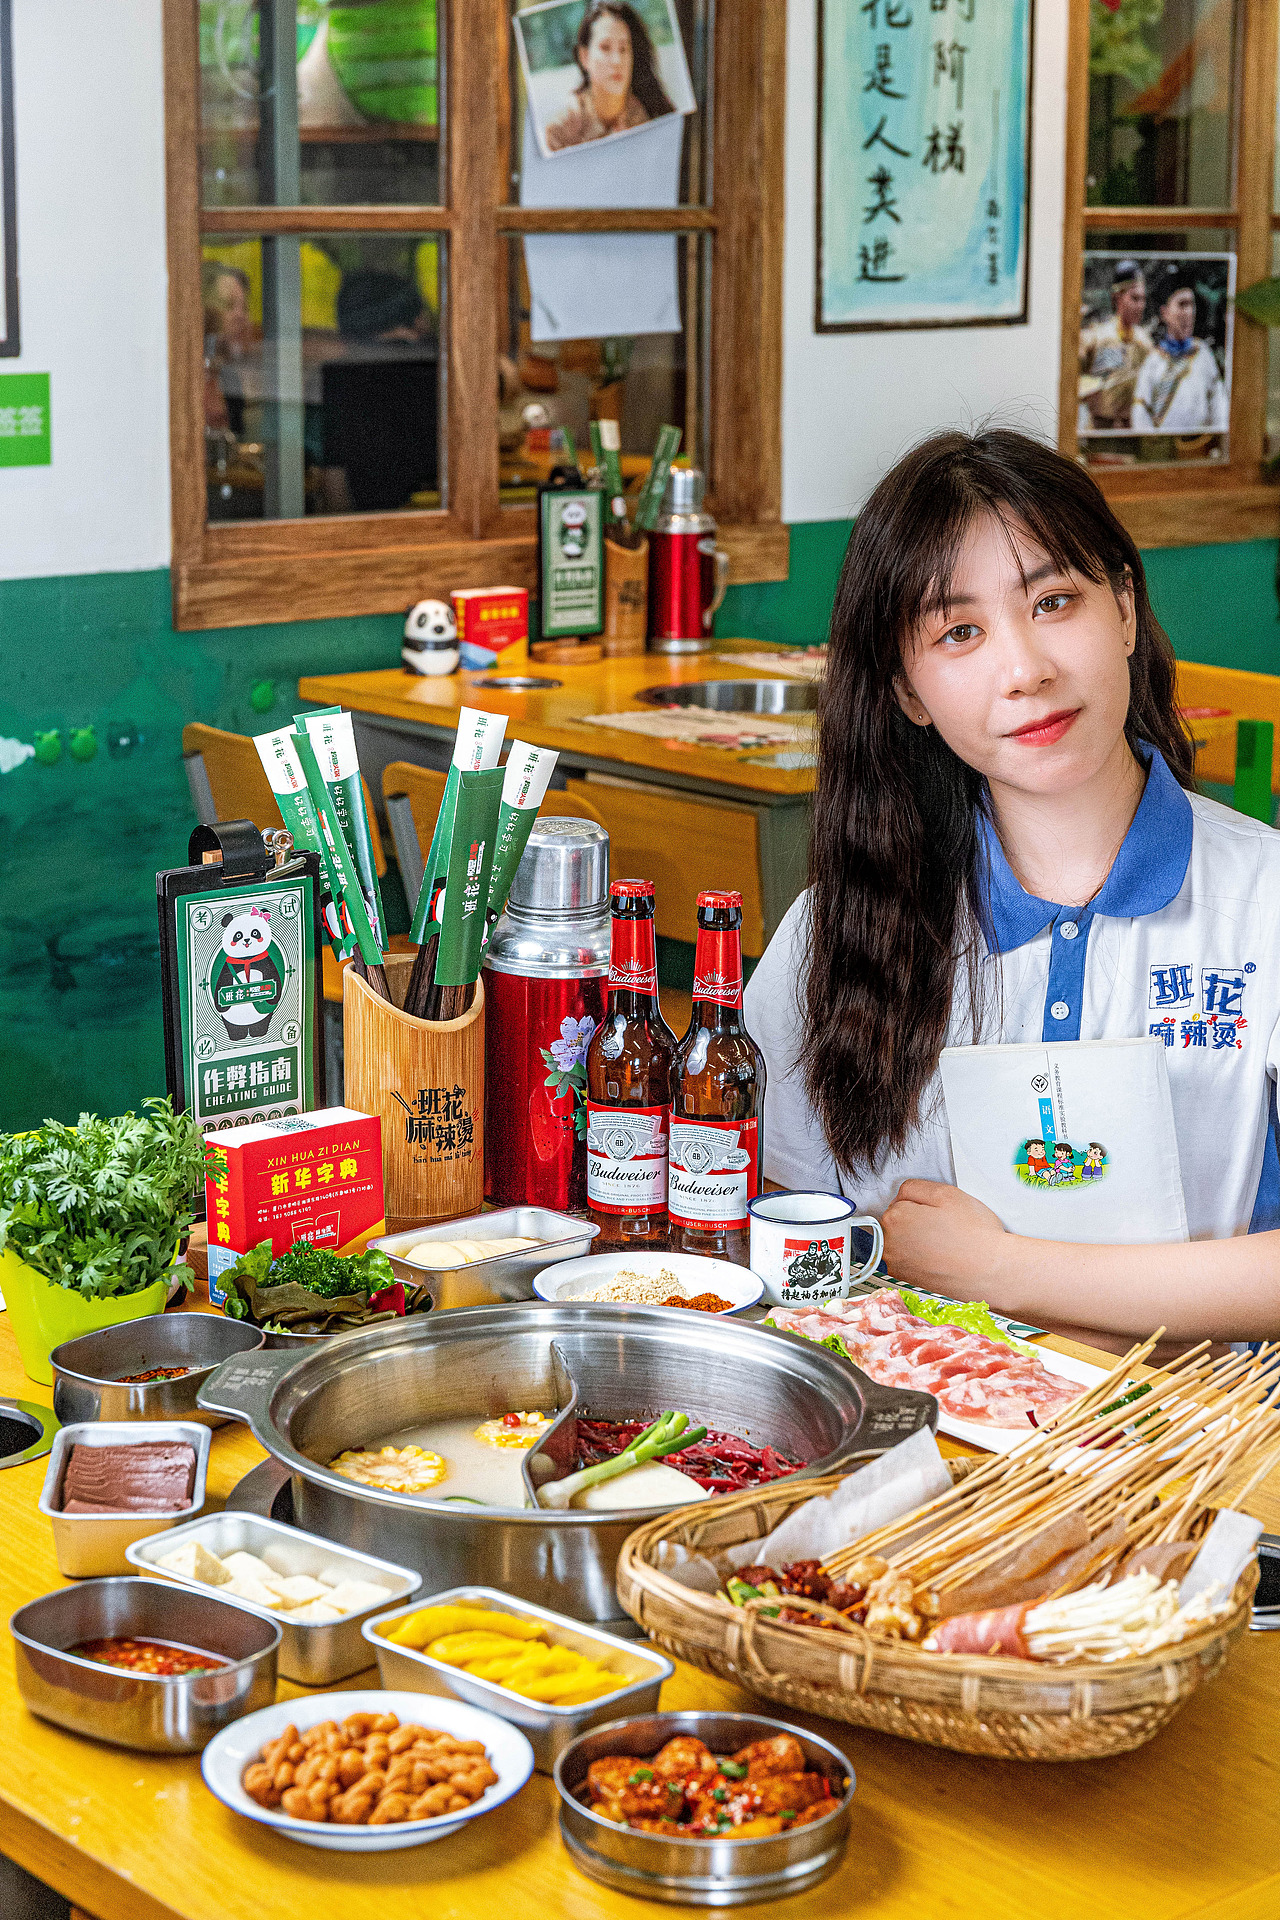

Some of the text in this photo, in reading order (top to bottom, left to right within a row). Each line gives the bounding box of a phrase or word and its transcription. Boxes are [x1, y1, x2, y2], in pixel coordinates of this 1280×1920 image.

[194, 898, 298, 927] 考 试
[463, 883, 481, 914] 班花
[609, 969, 656, 984] Budweiser
[693, 981, 741, 996] Budweiser
[1150, 965, 1247, 1016] 班花
[197, 1025, 298, 1057] 必 备
[1149, 1019, 1237, 1049] 麻辣烫
[203, 1056, 292, 1095] 作弊指南
[205, 1082, 292, 1108] CHEATING GUIDE
[416, 1086, 465, 1122] 班花
[1041, 1104, 1054, 1135] 语文
[267, 1139, 361, 1169] XIN HUA ZI DIAN
[271, 1157, 358, 1196] 新华字典
[589, 1159, 662, 1181] Budweiser
[669, 1171, 740, 1196] Budweiser
[600, 1205, 651, 1214] HEUSER-BUSCH
[677, 1219, 728, 1229] HEUSER-BUSCH
